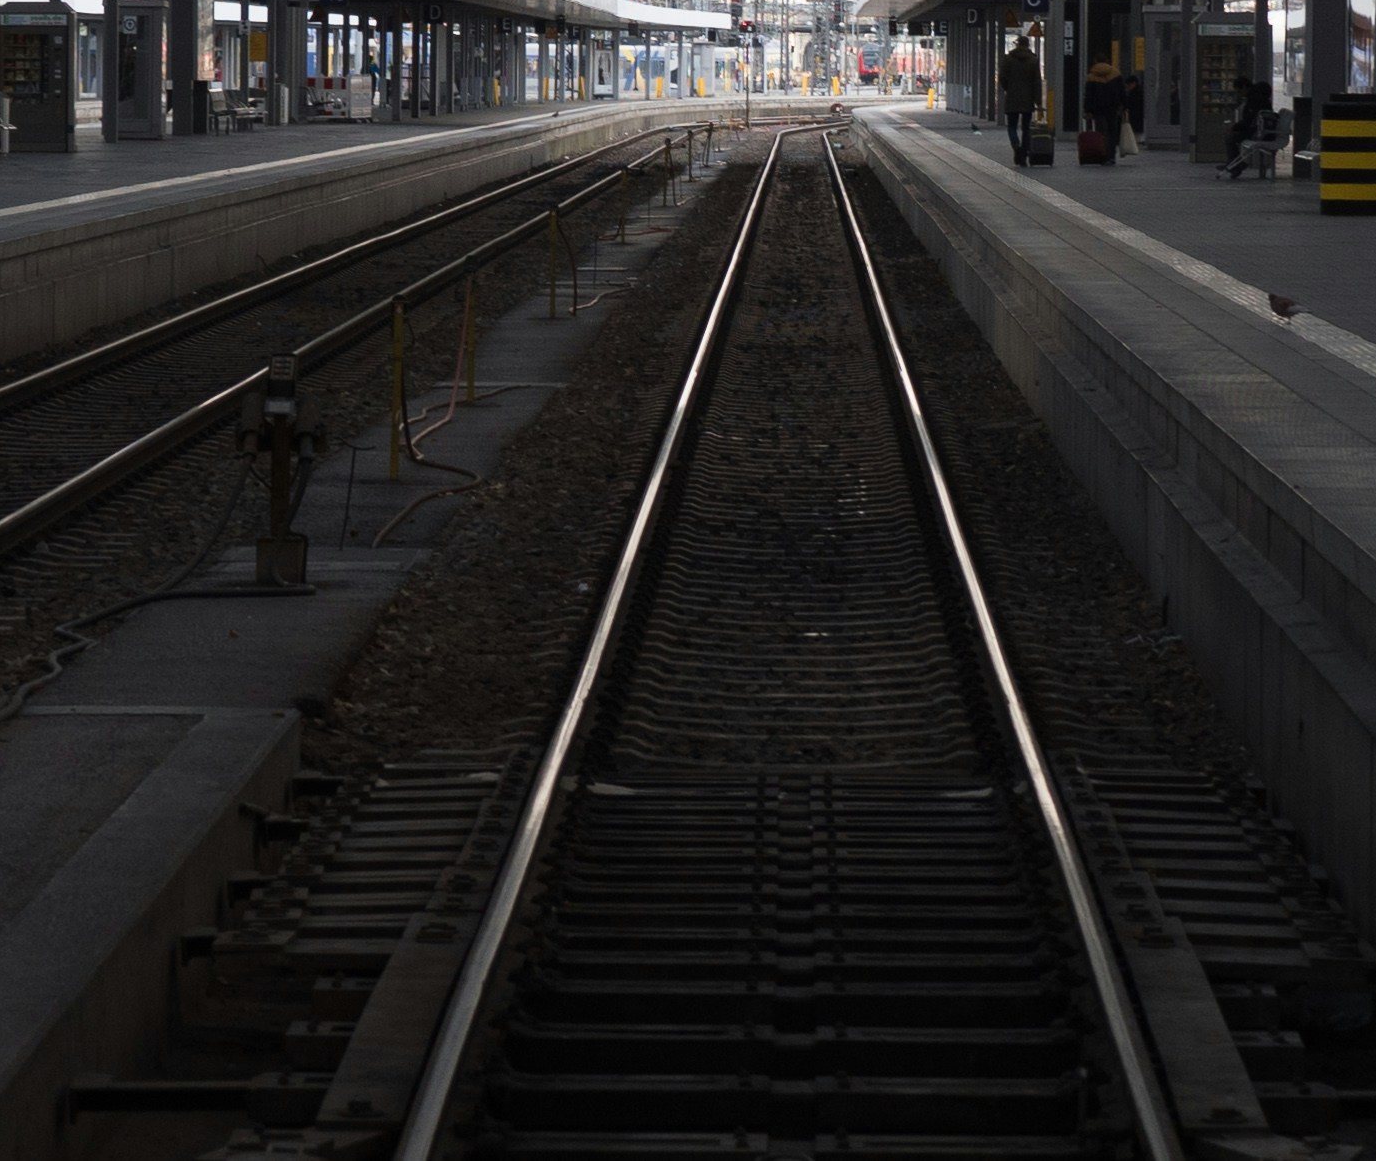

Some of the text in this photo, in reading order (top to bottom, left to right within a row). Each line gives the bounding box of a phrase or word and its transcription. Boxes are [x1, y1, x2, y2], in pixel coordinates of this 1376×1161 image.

[429, 4, 442, 20] D
[967, 8, 978, 24] D
[502, 17, 511, 30] E
[939, 21, 948, 34] E
